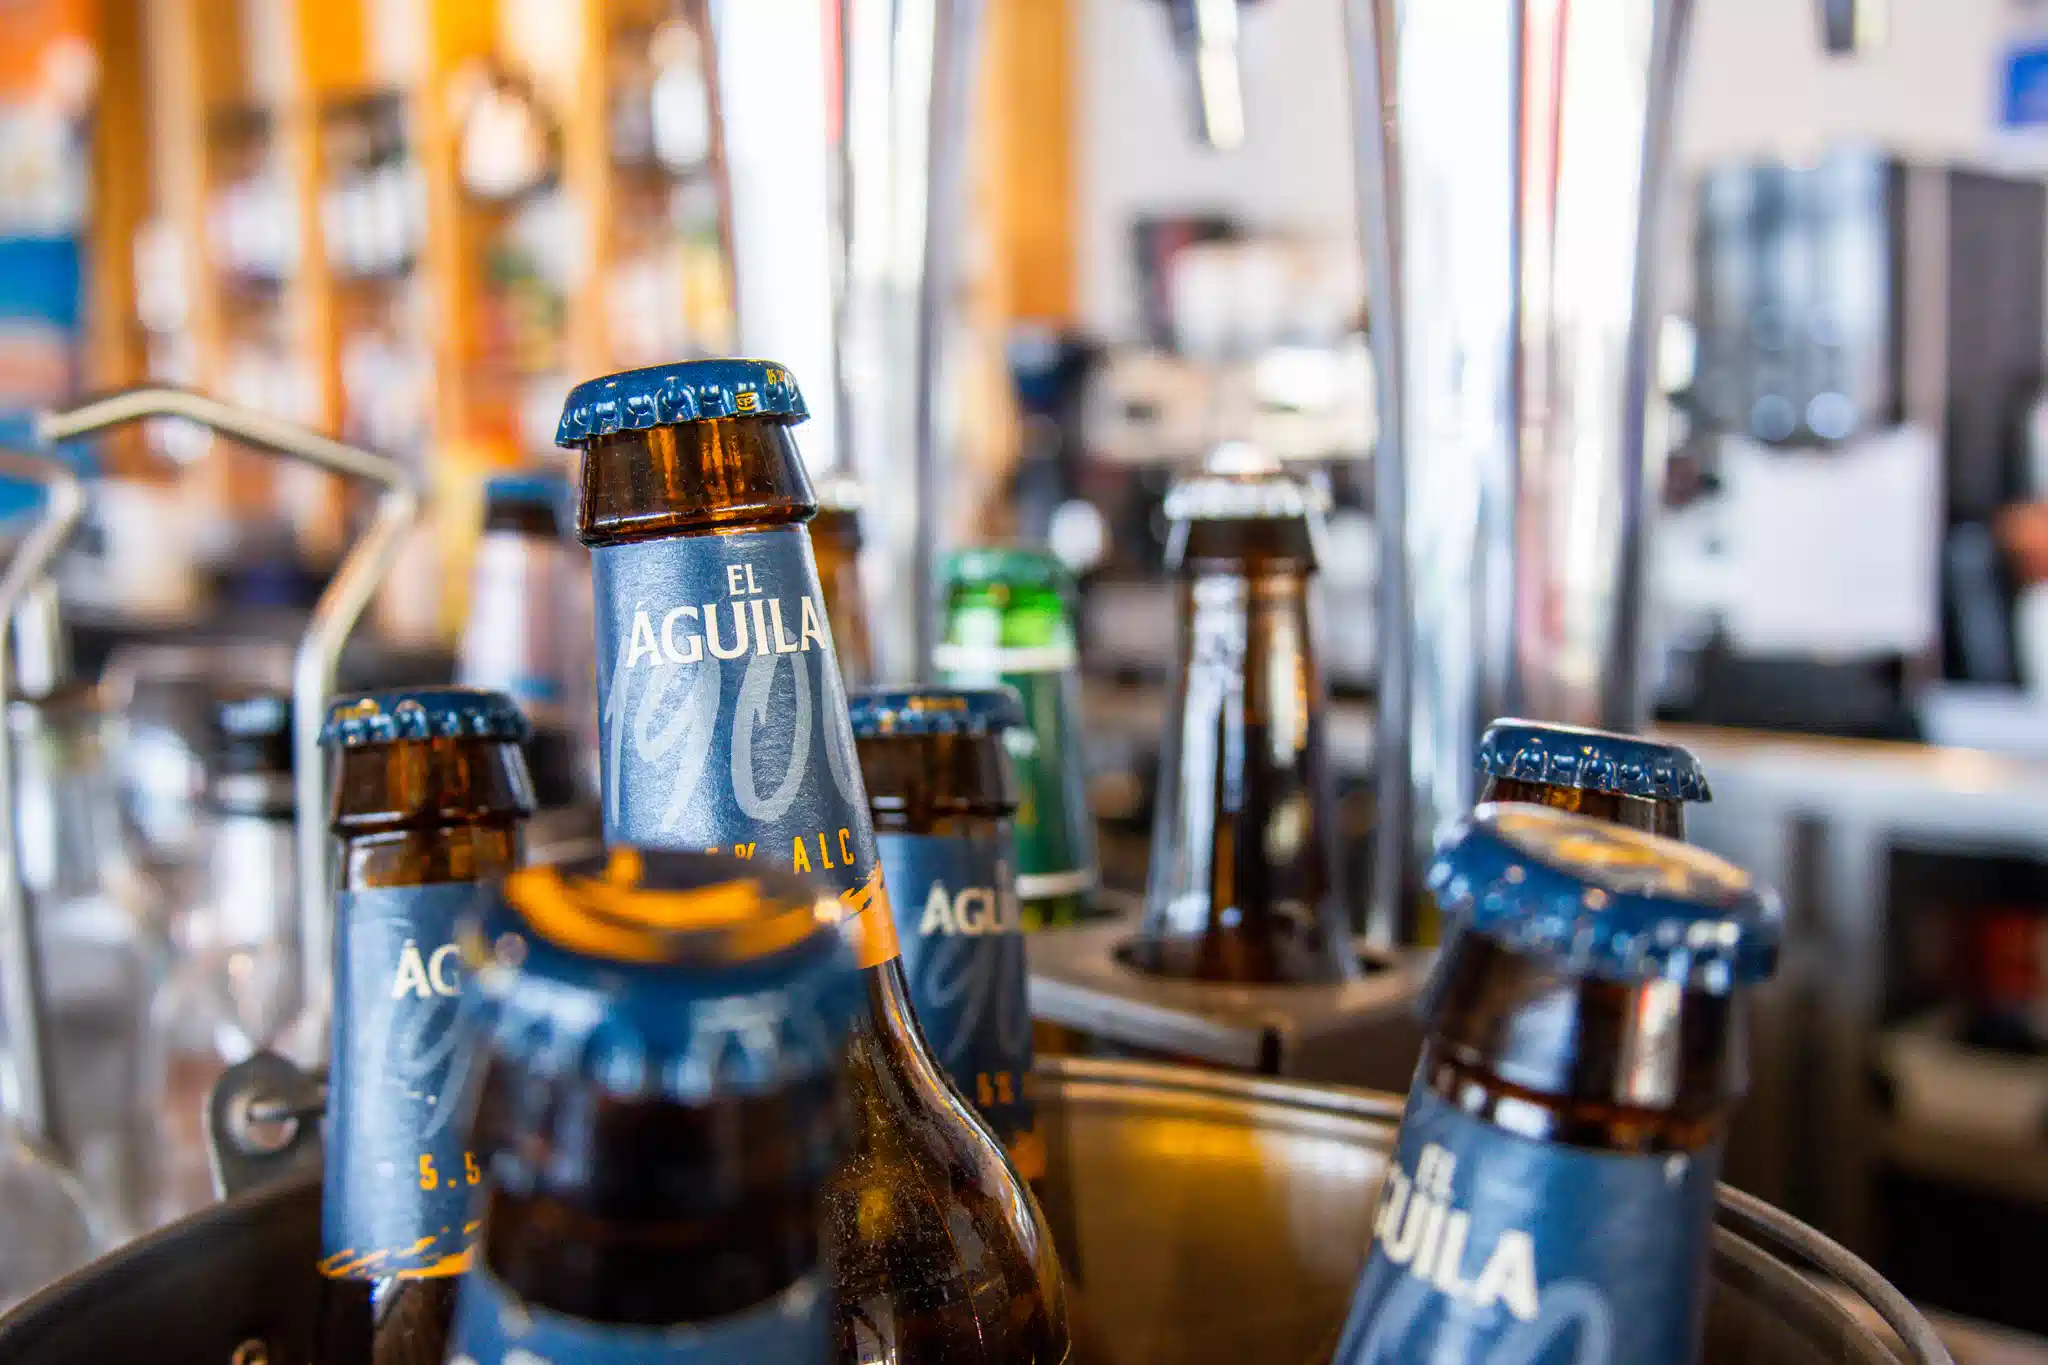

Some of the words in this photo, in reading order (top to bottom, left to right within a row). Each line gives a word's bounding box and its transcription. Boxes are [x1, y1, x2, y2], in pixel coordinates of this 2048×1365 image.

[726, 563, 763, 596] EL
[626, 594, 827, 669] ÁGUILA
[793, 827, 855, 874] ALC
[1373, 1160, 1540, 1323] UILA
